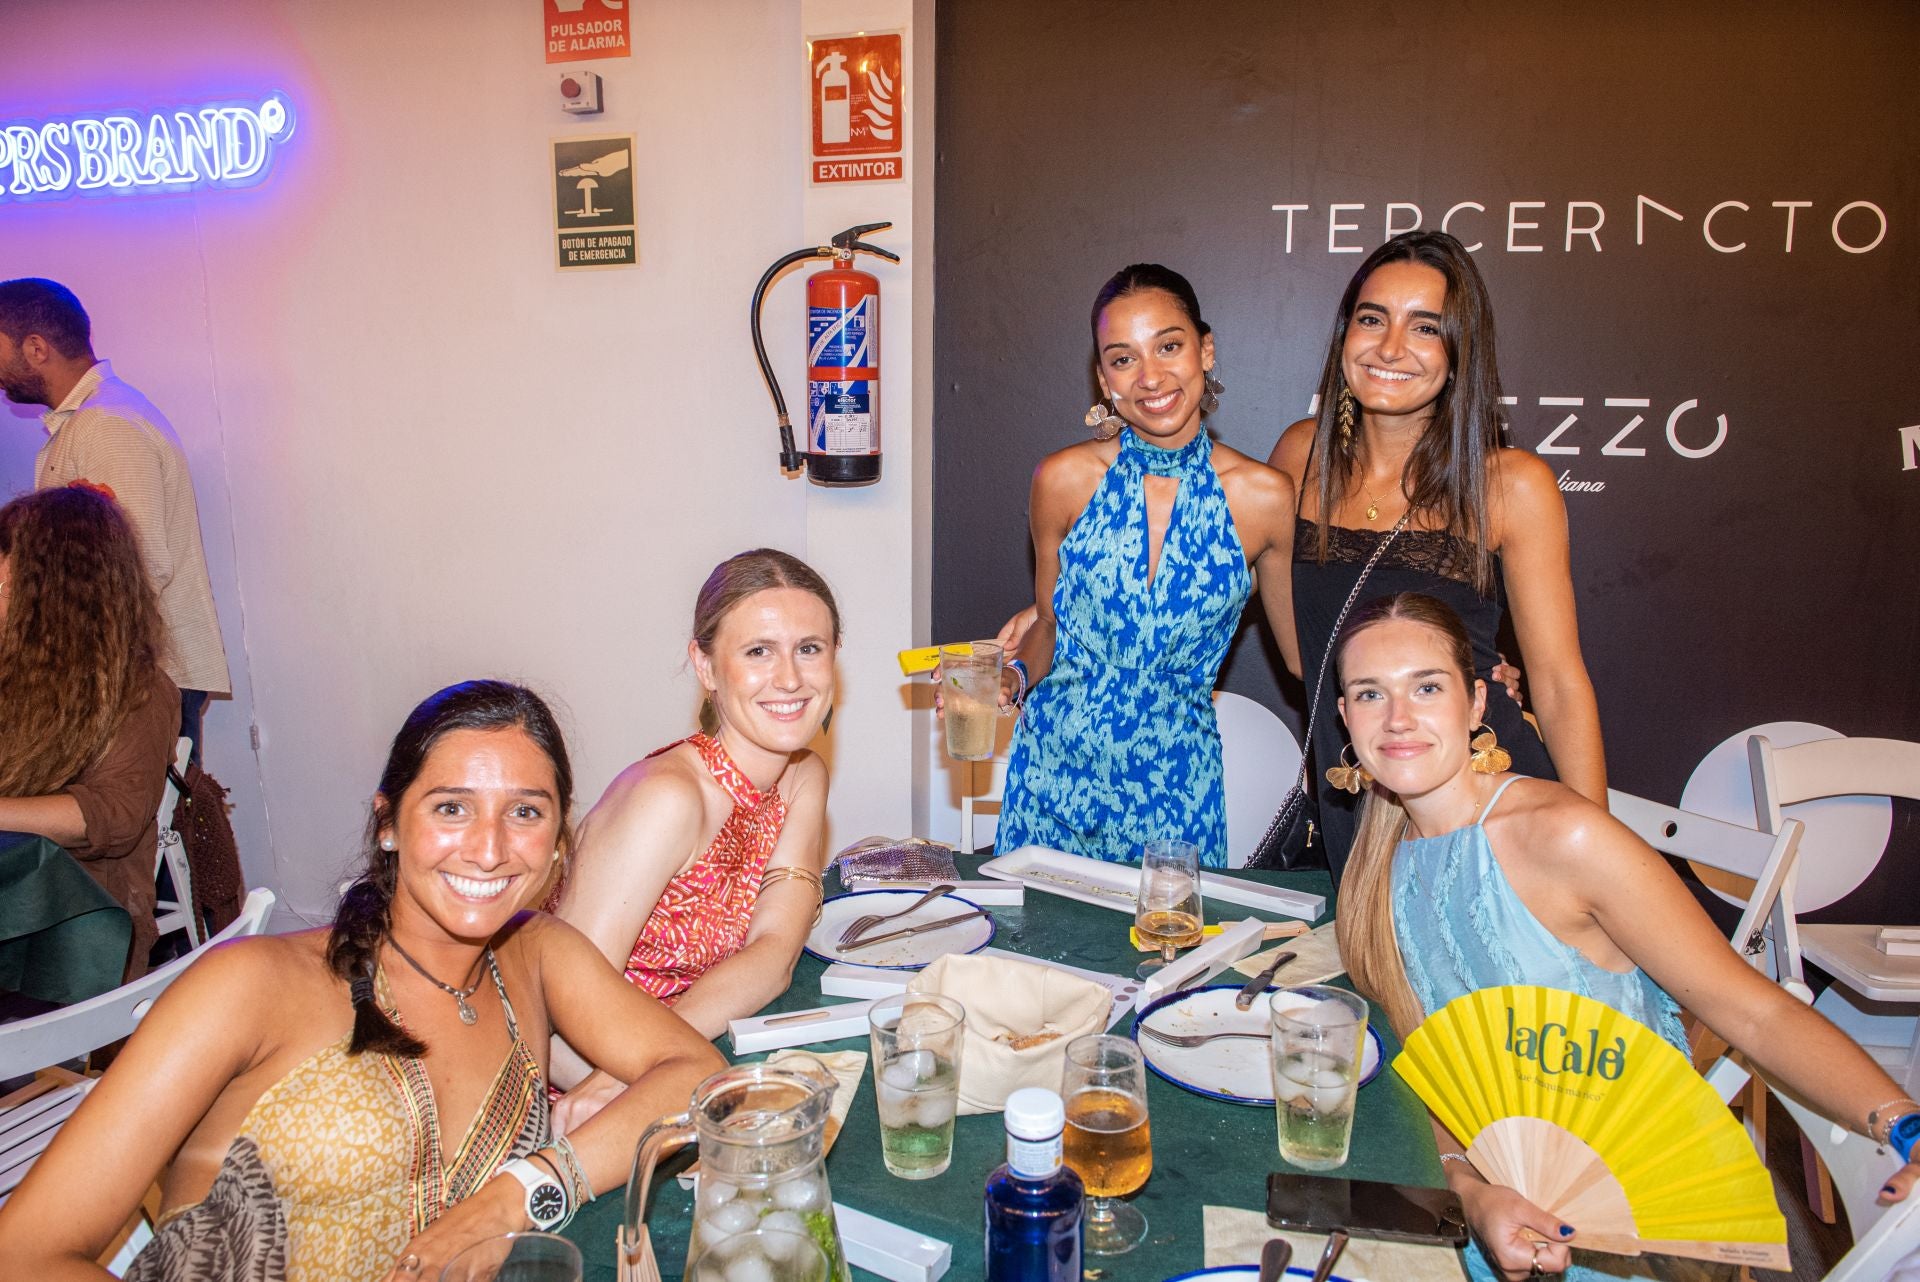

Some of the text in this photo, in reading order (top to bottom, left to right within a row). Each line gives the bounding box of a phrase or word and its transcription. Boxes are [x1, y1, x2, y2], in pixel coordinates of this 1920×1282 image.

[551, 19, 622, 37] PULSADOR
[549, 35, 625, 53] DE ALARMA
[819, 162, 896, 179] EXTINTOR
[587, 237, 597, 248] DE
[598, 235, 632, 247] APAGADO
[568, 248, 626, 261] DE EMERGENCIA
